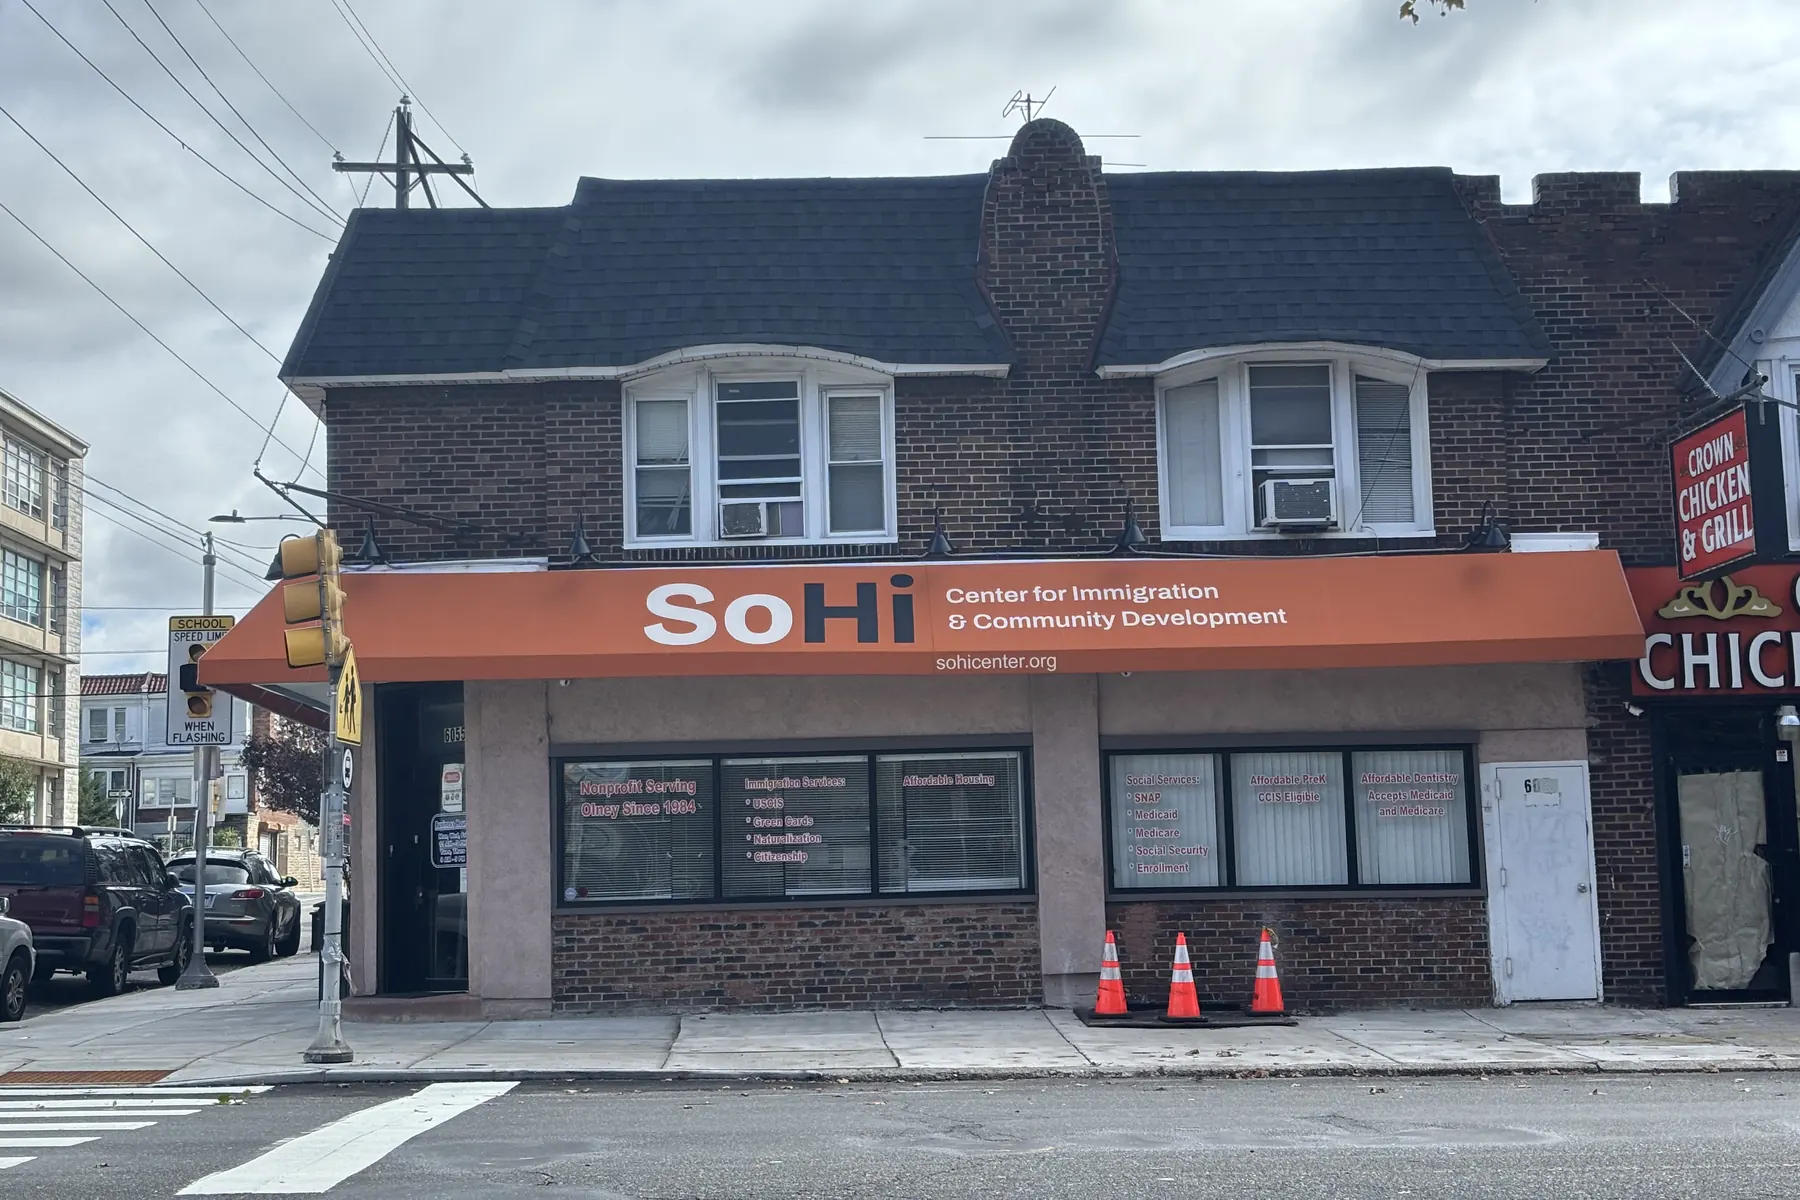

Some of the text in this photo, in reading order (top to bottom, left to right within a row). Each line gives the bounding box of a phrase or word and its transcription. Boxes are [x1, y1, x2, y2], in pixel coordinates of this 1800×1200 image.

[1688, 431, 1734, 478] CROWN
[1679, 461, 1751, 522] CHICKEN
[1682, 504, 1754, 561] & GRILL
[945, 583, 1220, 604] Center for Immigration
[643, 573, 915, 646] SoHi
[177, 618, 227, 629] SCHOOL
[947, 607, 1288, 631] & Community Development
[174, 632, 228, 642] SPEED LIM
[935, 654, 1057, 672] sohicenter.org
[184, 721, 215, 732] WHEN
[173, 732, 225, 743] FLASHING
[745, 776, 846, 791] Immigration Services:
[903, 773, 995, 786] Affordable Housing
[1126, 774, 1200, 785] Social Services:
[1250, 774, 1327, 786] Affordable PreK
[1361, 772, 1459, 785] Affordable Dentistry
[580, 778, 696, 797] Nonprofit Serving
[1134, 792, 1161, 803] SNAP
[1258, 791, 1320, 804] CCIS Eligible
[1368, 789, 1454, 803] Accepts Medicaid
[581, 799, 696, 819] Olney Since 1984
[753, 798, 784, 809] USCIS
[1135, 809, 1178, 820] Medicaid
[1379, 805, 1444, 816] and Medicare
[753, 815, 814, 827] Green Cards
[754, 832, 822, 844] Naturalization
[1135, 828, 1180, 838] Medicare
[754, 850, 808, 863] Citizenship
[1136, 845, 1208, 857] Social Security
[1137, 862, 1189, 873] Enrollment
